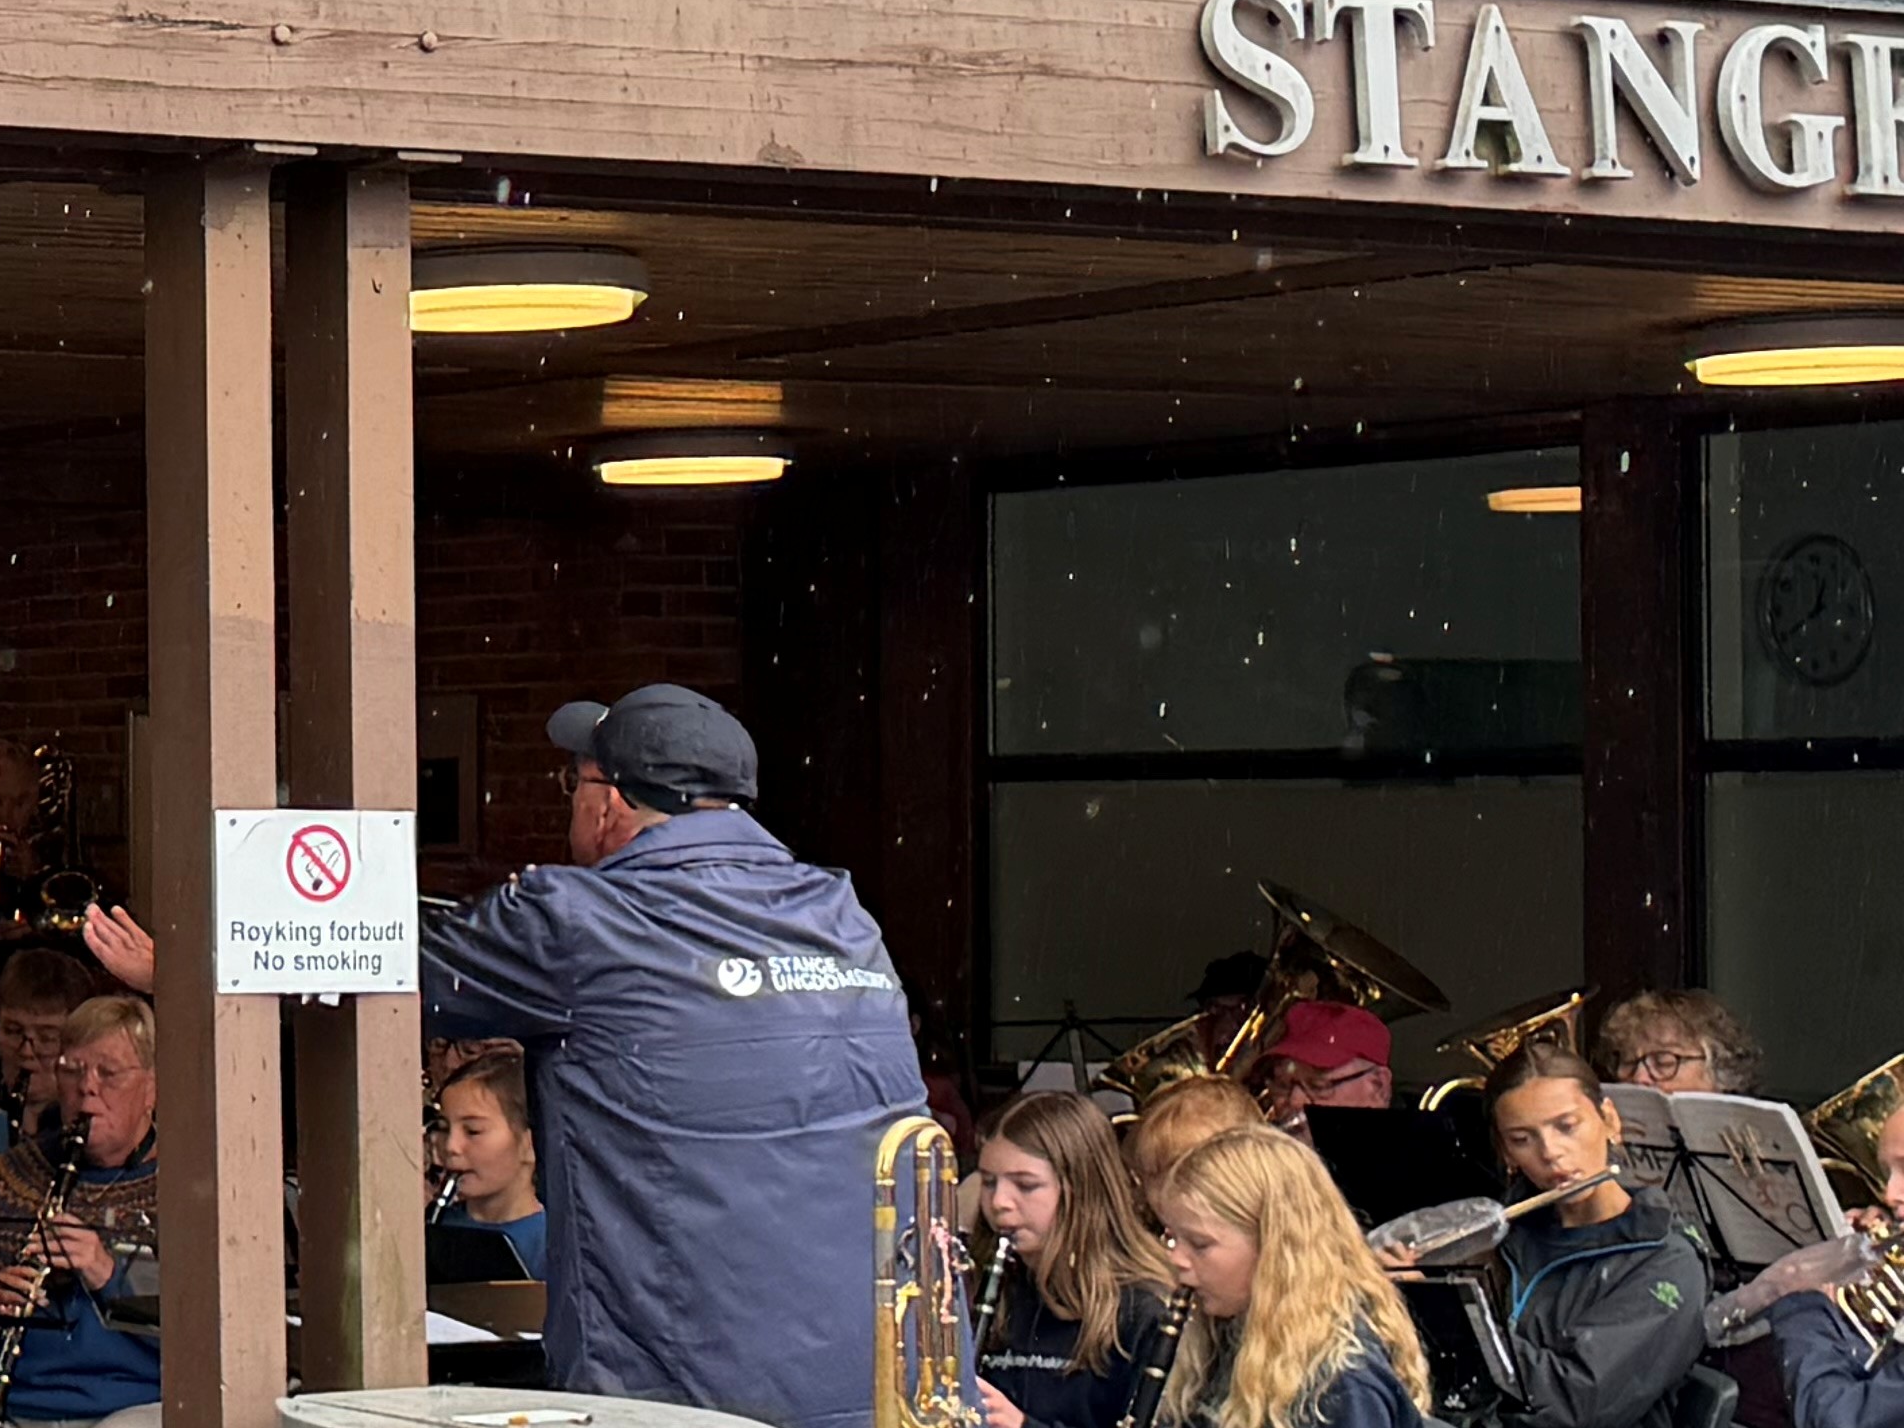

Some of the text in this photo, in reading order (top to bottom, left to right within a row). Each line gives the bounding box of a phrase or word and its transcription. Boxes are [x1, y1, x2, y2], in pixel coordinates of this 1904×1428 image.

[329, 919, 404, 941] forbudt
[253, 949, 382, 976] No smoking
